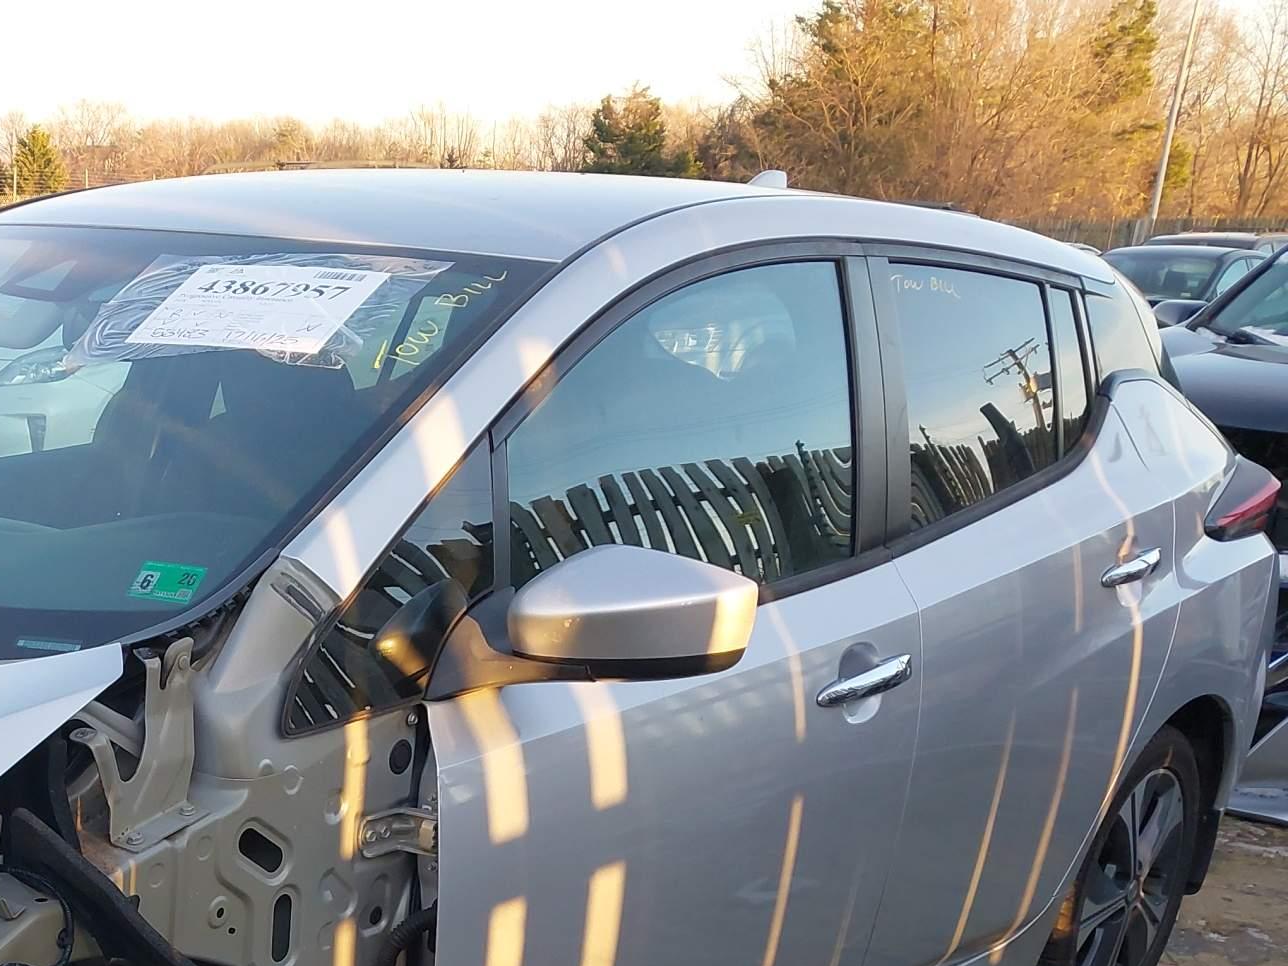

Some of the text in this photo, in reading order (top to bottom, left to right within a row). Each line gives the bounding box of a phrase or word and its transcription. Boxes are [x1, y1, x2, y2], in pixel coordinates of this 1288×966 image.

[197, 279, 352, 301] 43867957
[434, 270, 508, 309] BILL
[139, 573, 154, 590] 6
[177, 572, 198, 587] 26
